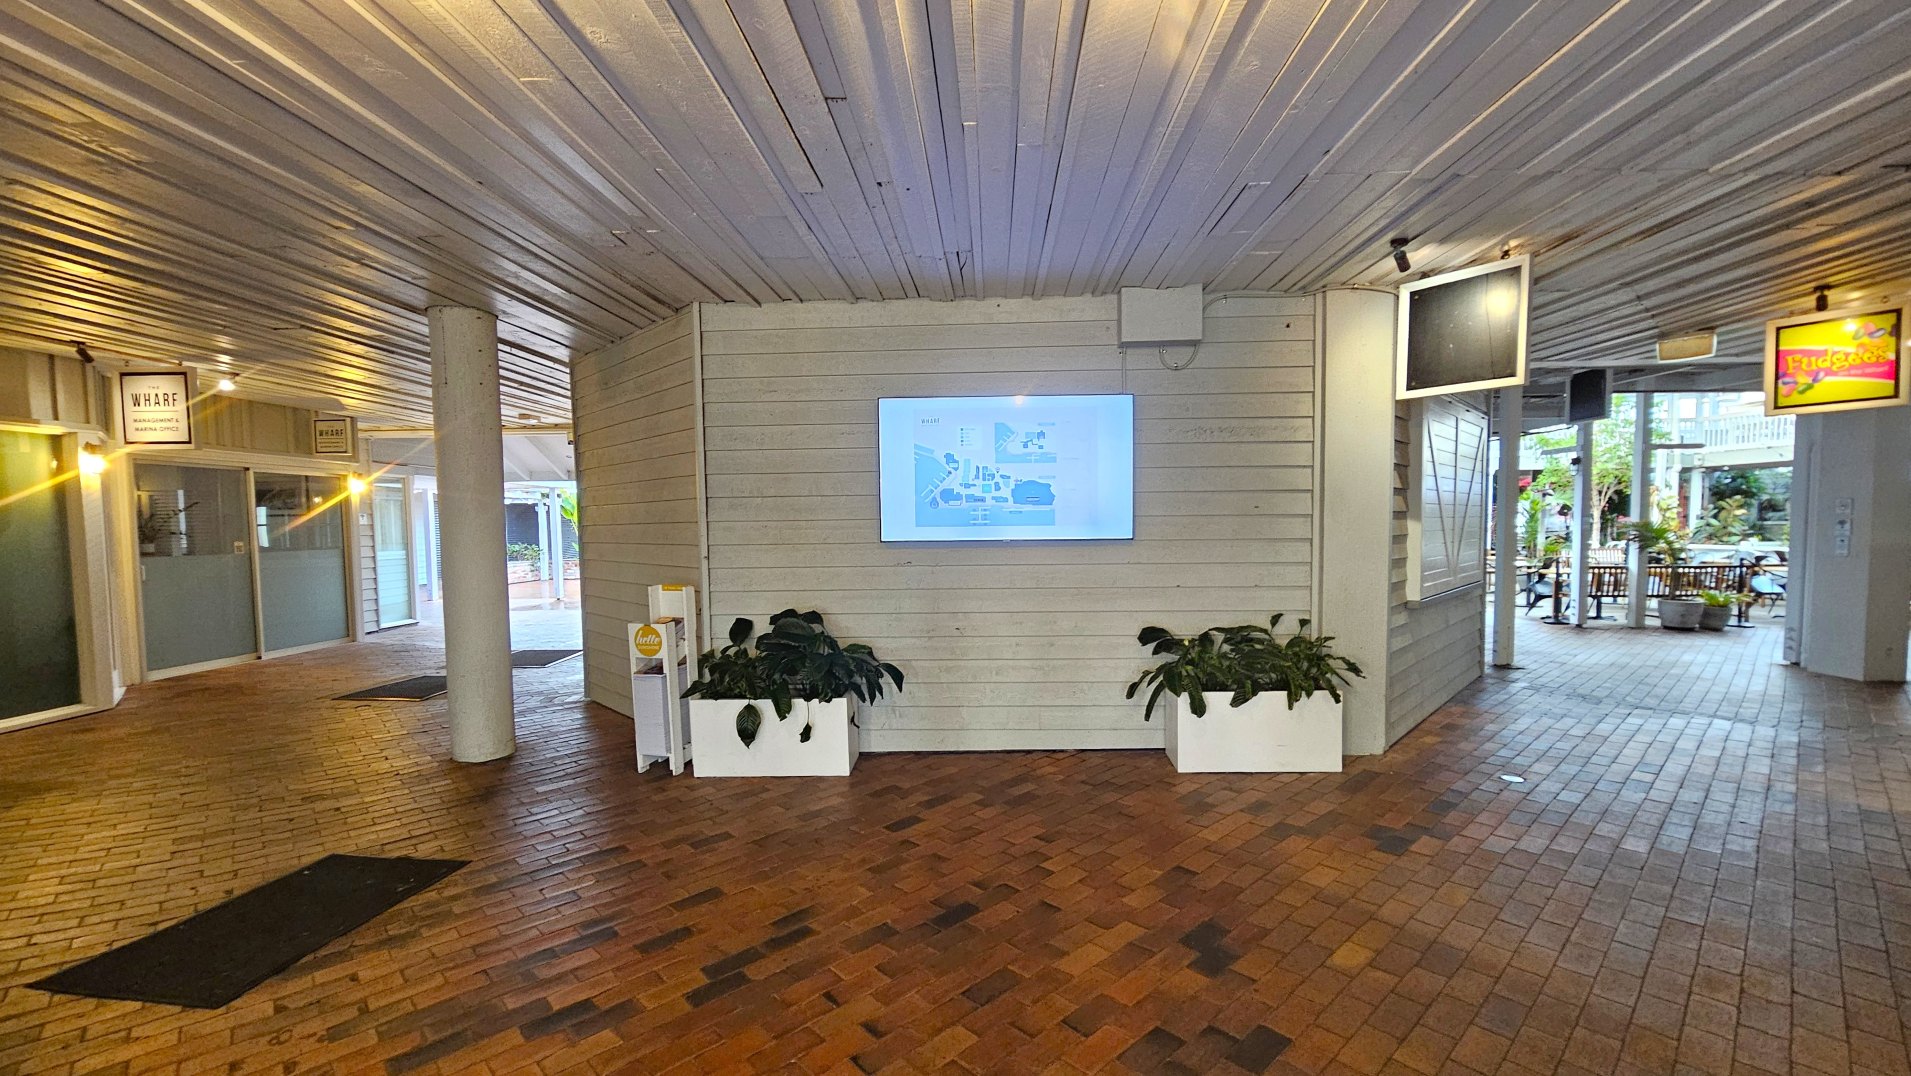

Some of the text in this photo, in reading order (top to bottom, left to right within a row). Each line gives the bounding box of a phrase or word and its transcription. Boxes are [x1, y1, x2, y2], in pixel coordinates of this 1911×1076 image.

[131, 392, 178, 407] WHARF
[318, 429, 344, 437] WHARF
[636, 630, 661, 645] hello
